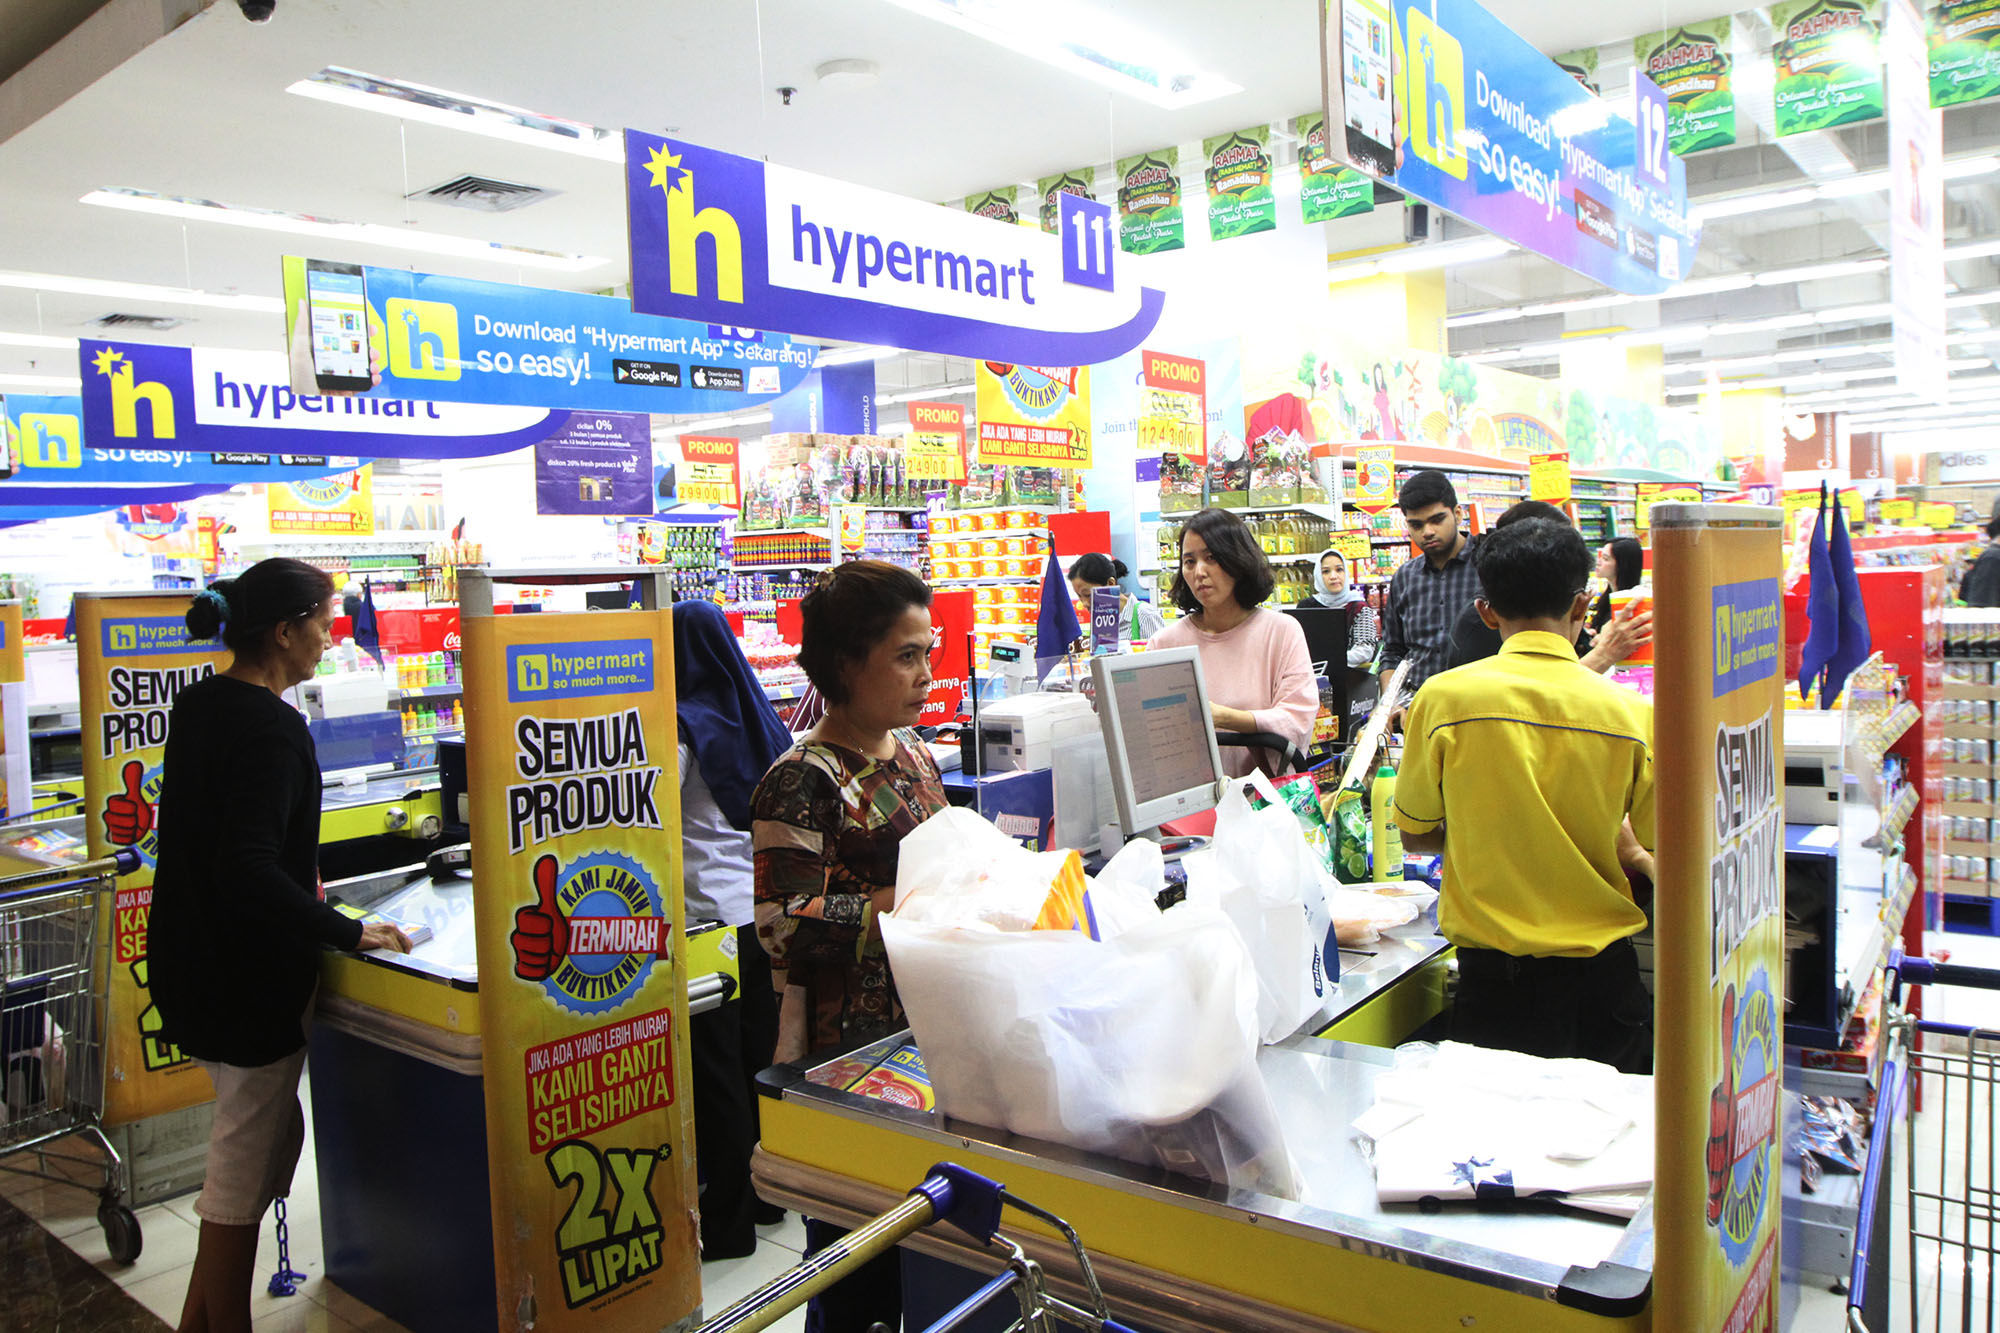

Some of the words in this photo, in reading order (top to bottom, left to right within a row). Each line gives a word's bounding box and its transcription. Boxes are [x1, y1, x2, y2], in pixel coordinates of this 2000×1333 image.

[1789, 11, 1863, 41] RAHMAT
[1650, 44, 1715, 72] RAHMAT
[1666, 77, 1716, 96] madhan
[1475, 69, 1551, 151] Download
[1640, 95, 1667, 184] 12
[1214, 146, 1259, 168] RAHMAT
[1127, 168, 1168, 189] RAHMAT
[1216, 173, 1261, 193] Ramadhan
[1477, 133, 1507, 182] so
[1509, 153, 1562, 222] easy!
[1128, 194, 1170, 212] Ramadhan
[666, 168, 744, 304] h
[1071, 210, 1107, 275] 11
[791, 203, 1036, 305] hypermart
[473, 314, 577, 345] Download
[583, 325, 687, 355] “Hypermart
[689, 337, 730, 360] App”
[733, 340, 812, 368] Sekarang!
[476, 350, 515, 372] so
[519, 352, 592, 386] easy!
[630, 370, 660, 383] Google
[661, 371, 678, 384] Play
[709, 377, 723, 386] App
[723, 378, 740, 387] Store
[1151, 358, 1200, 384] PROMO
[110, 360, 176, 439] h
[1010, 371, 1061, 408] BUKTIKAN!
[595, 419, 613, 431] 0%
[915, 408, 960, 425] PROMO
[1101, 421, 1126, 434] Join
[982, 439, 1002, 454] KAMI
[1003, 440, 1026, 455] GANTI
[996, 425, 1010, 440] ADA
[1010, 426, 1027, 442] YANG
[1141, 425, 1194, 448] 124300
[688, 441, 734, 455] PROMO
[907, 459, 947, 474] 24900
[679, 486, 718, 500] 29900
[139, 624, 190, 641] hyper
[1095, 614, 1116, 628] OVO
[1731, 600, 1778, 644] hypermart
[140, 640, 153, 649] so
[154, 637, 185, 648] much
[522, 658, 543, 687] h
[551, 650, 647, 675] hypermart
[552, 678, 569, 689] so
[571, 674, 604, 688] much
[606, 672, 647, 685] more...
[920, 701, 946, 713] rang
[101, 708, 173, 761] PRO
[515, 707, 649, 781] SEMUA
[1714, 705, 1776, 847] SEMUA
[116, 891, 136, 910] JIKA
[559, 867, 600, 908] KAMI
[605, 868, 650, 914] JAMIN
[1709, 806, 1781, 990] PRODUK
[570, 919, 660, 953] TERMURAH
[556, 953, 643, 1000] BUKTIKAN!
[528, 1048, 551, 1074] JIKA
[551, 1044, 574, 1067] ADA
[574, 1034, 602, 1063] YANG
[604, 1026, 632, 1051] LEBIH
[633, 1012, 668, 1042] MURAH
[532, 1059, 595, 1110] KAMI
[601, 1035, 668, 1085] GANTI
[534, 1070, 670, 1147] SELISIHNYA
[559, 1229, 662, 1309] LIPAT
